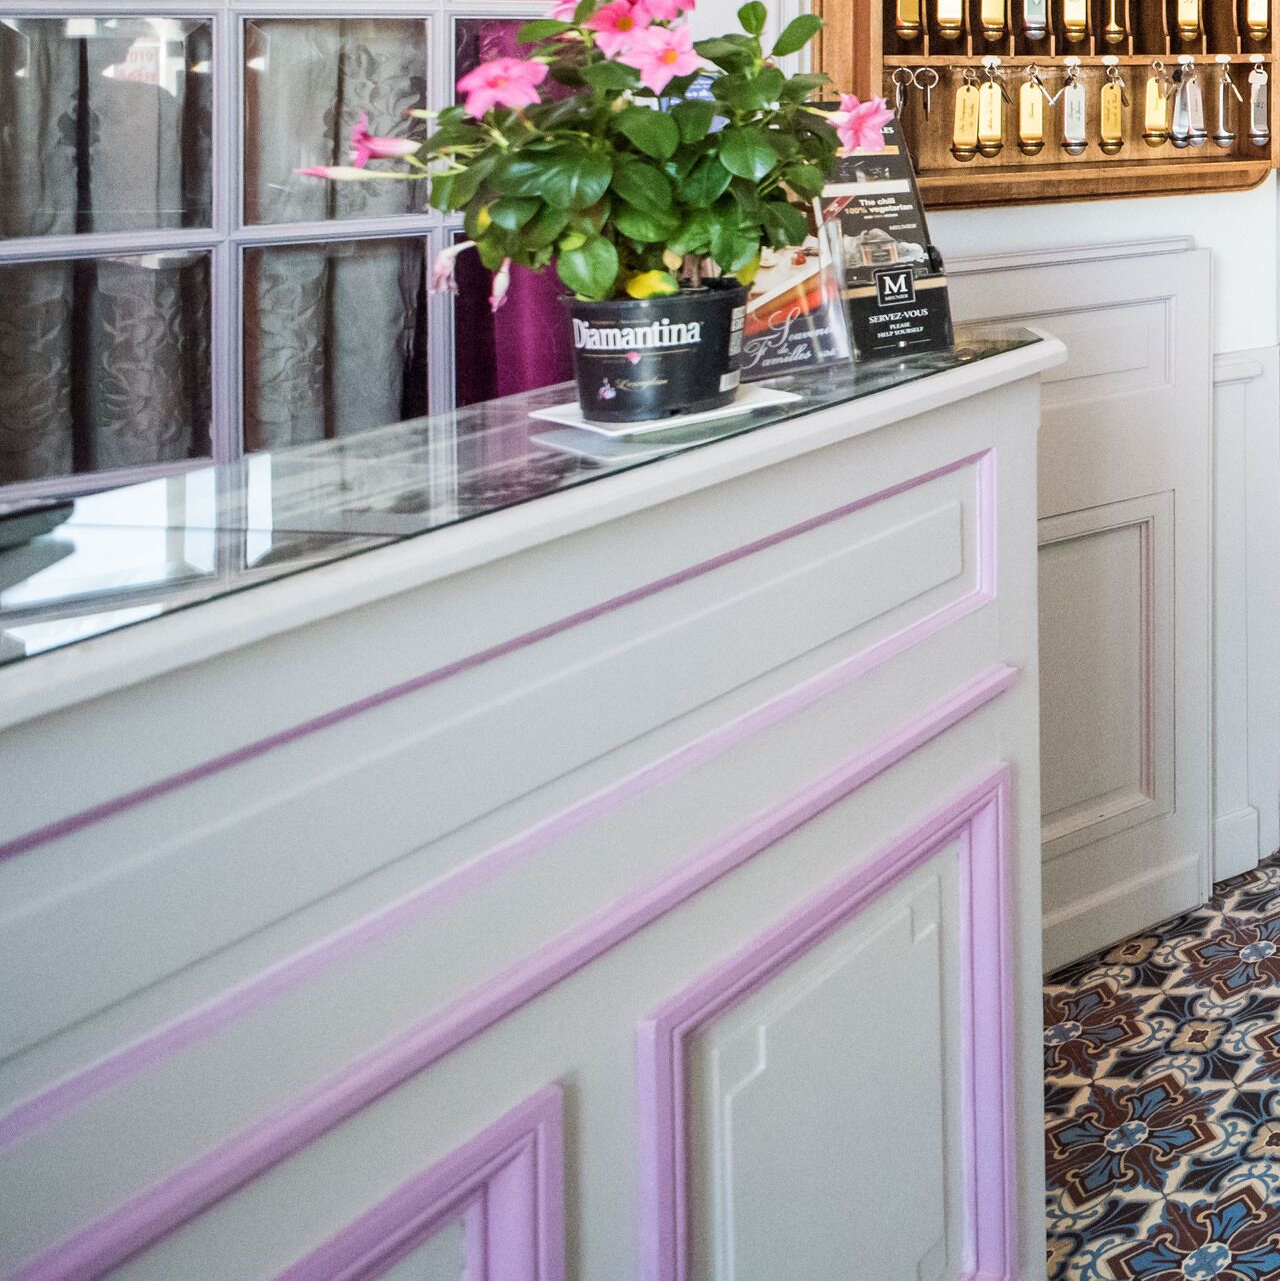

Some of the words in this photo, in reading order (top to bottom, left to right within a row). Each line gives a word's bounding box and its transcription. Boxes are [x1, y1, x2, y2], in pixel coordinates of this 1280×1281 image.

[858, 199, 876, 207] The
[883, 274, 909, 295] M
[868, 308, 929, 324] SERVEZ-VOUS
[877, 330, 895, 339] HELP
[894, 326, 924, 336] YOURSELF
[889, 321, 911, 330] PLEASE
[572, 318, 702, 349] Diamantina
